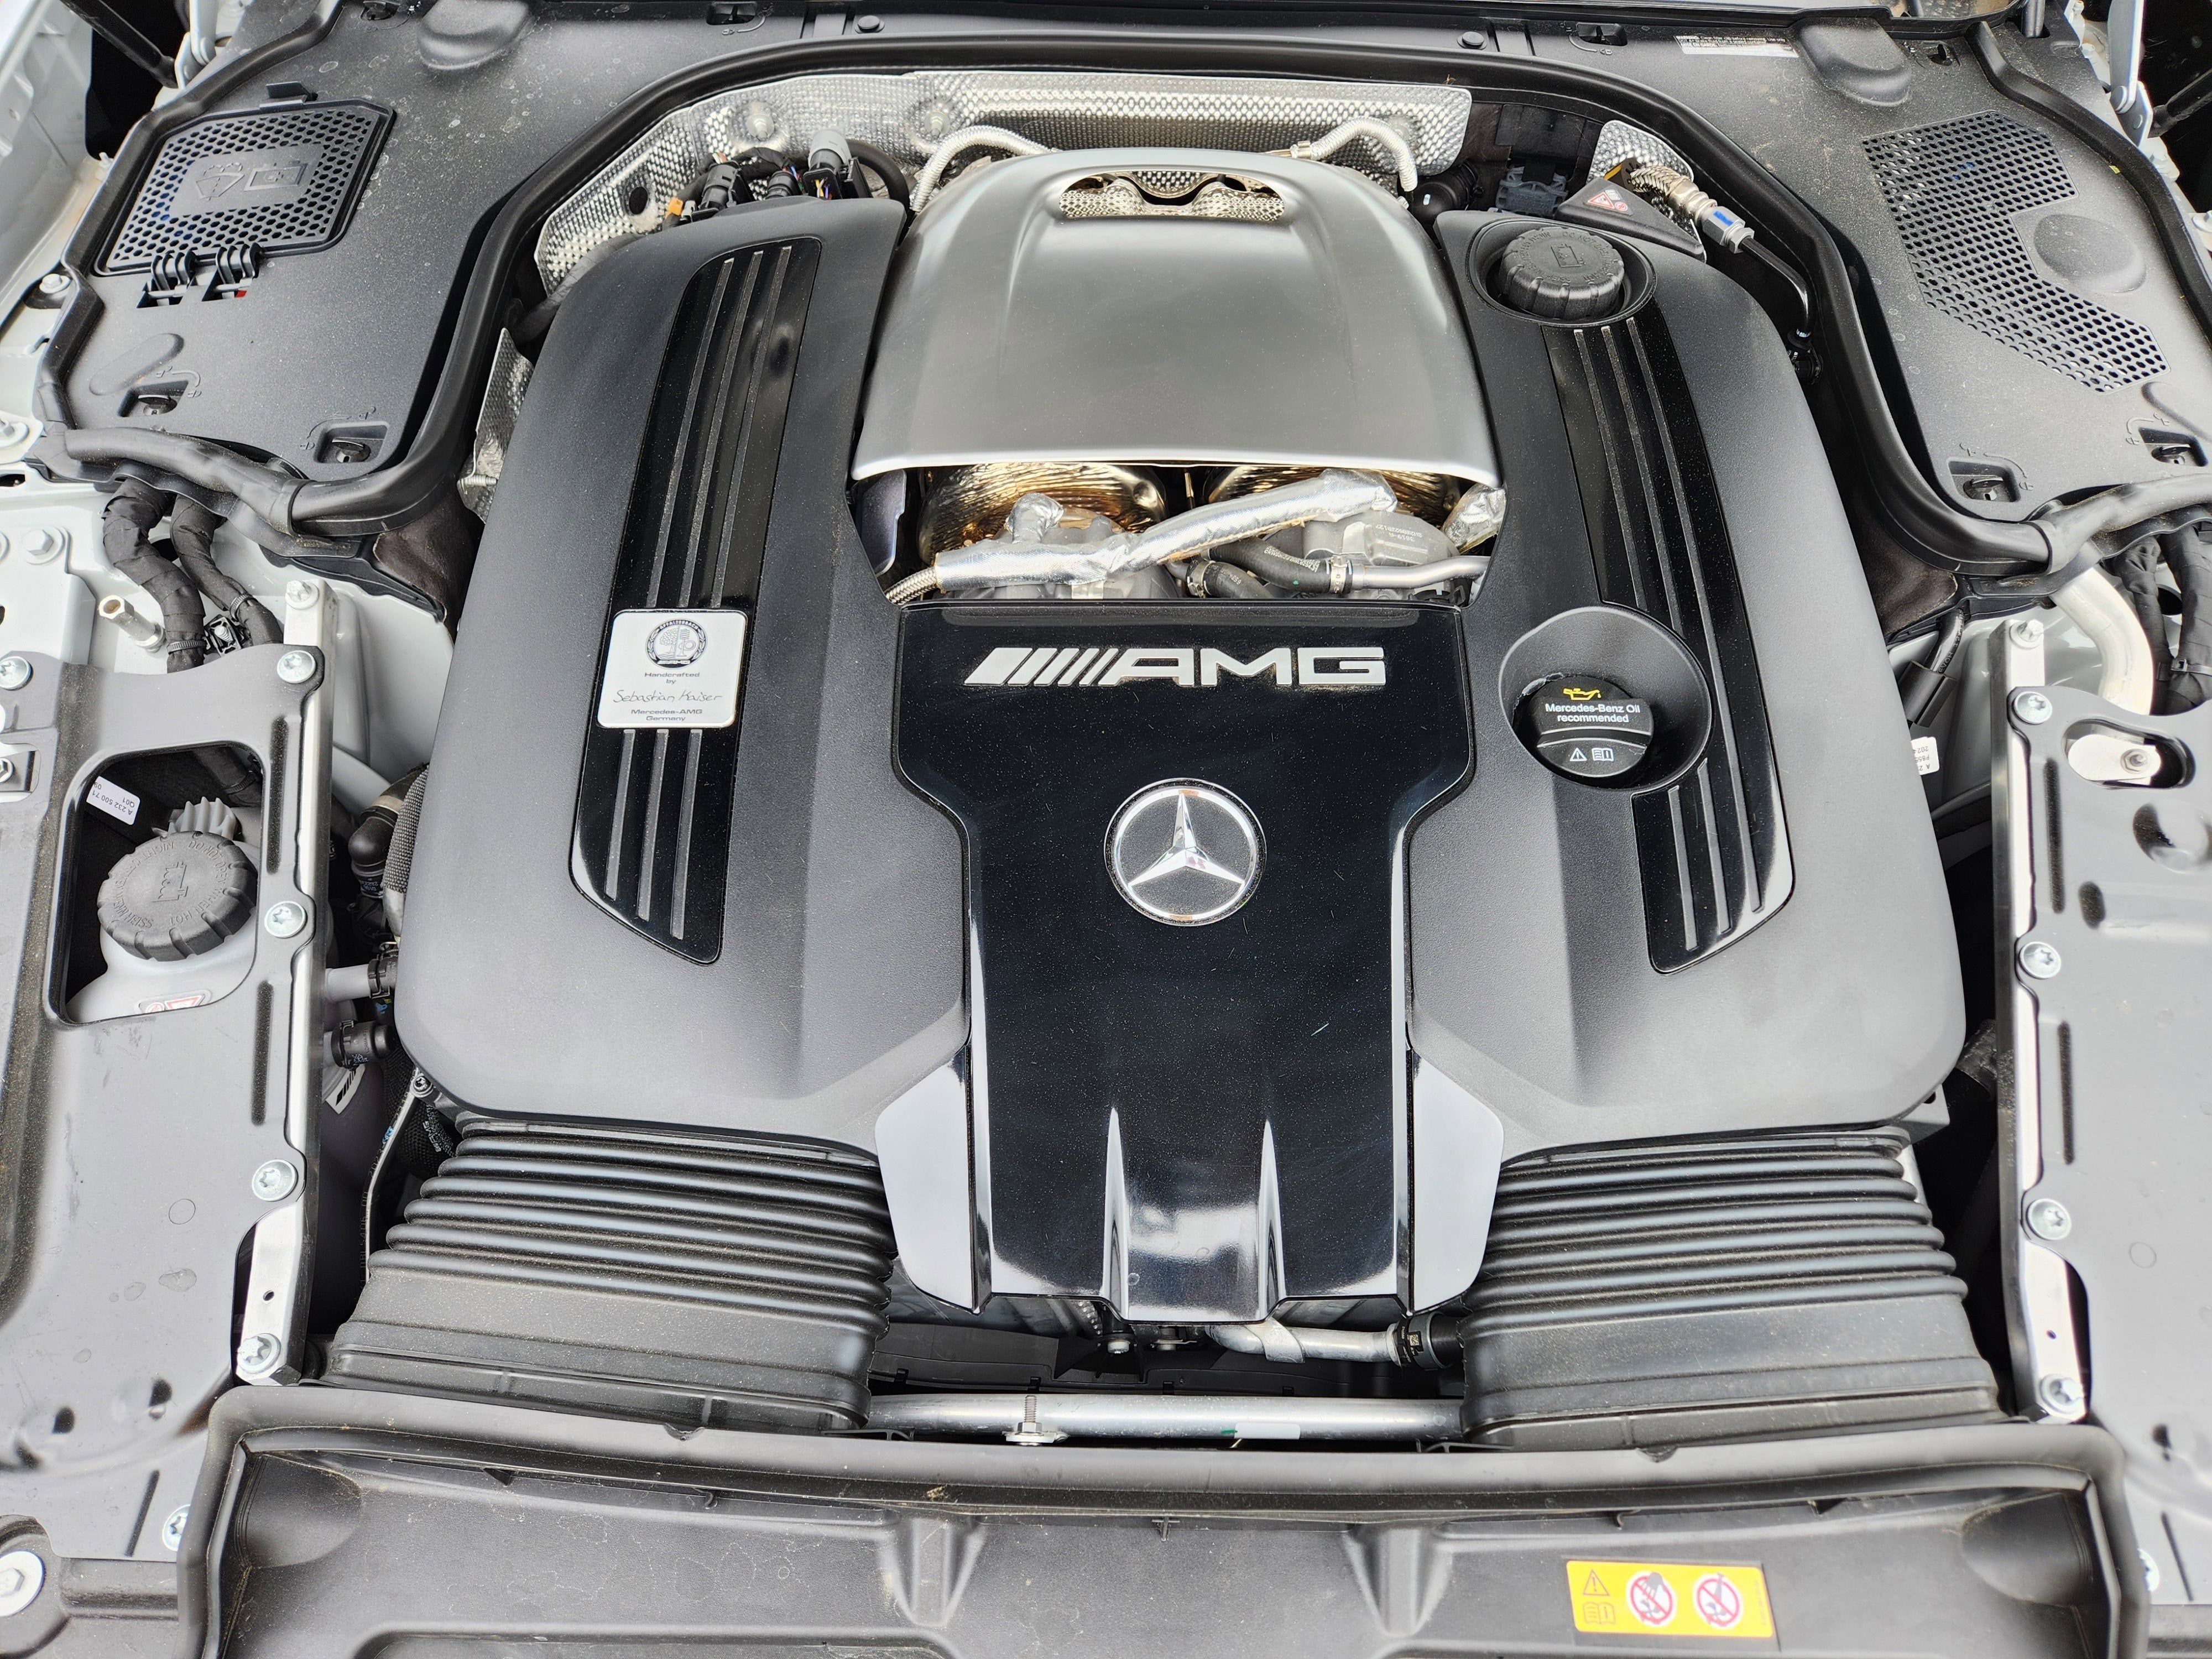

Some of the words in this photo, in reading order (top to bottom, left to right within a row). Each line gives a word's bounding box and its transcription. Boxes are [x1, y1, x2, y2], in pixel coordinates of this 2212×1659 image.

[1098, 646, 1386, 686] AMG
[613, 690, 675, 703] Sebastian
[678, 689, 723, 702] Kaiser
[1545, 703, 1625, 713] Mercedes-Benz
[1626, 704, 1641, 713] Oil
[1557, 713, 1629, 723] recommended
[92, 790, 100, 799] 71
[101, 795, 113, 805] 500
[114, 801, 126, 812] 232
[122, 797, 135, 808] Q01
[188, 839, 205, 850] DO
[204, 845, 223, 861] NOT
[169, 910, 192, 926] HOT
